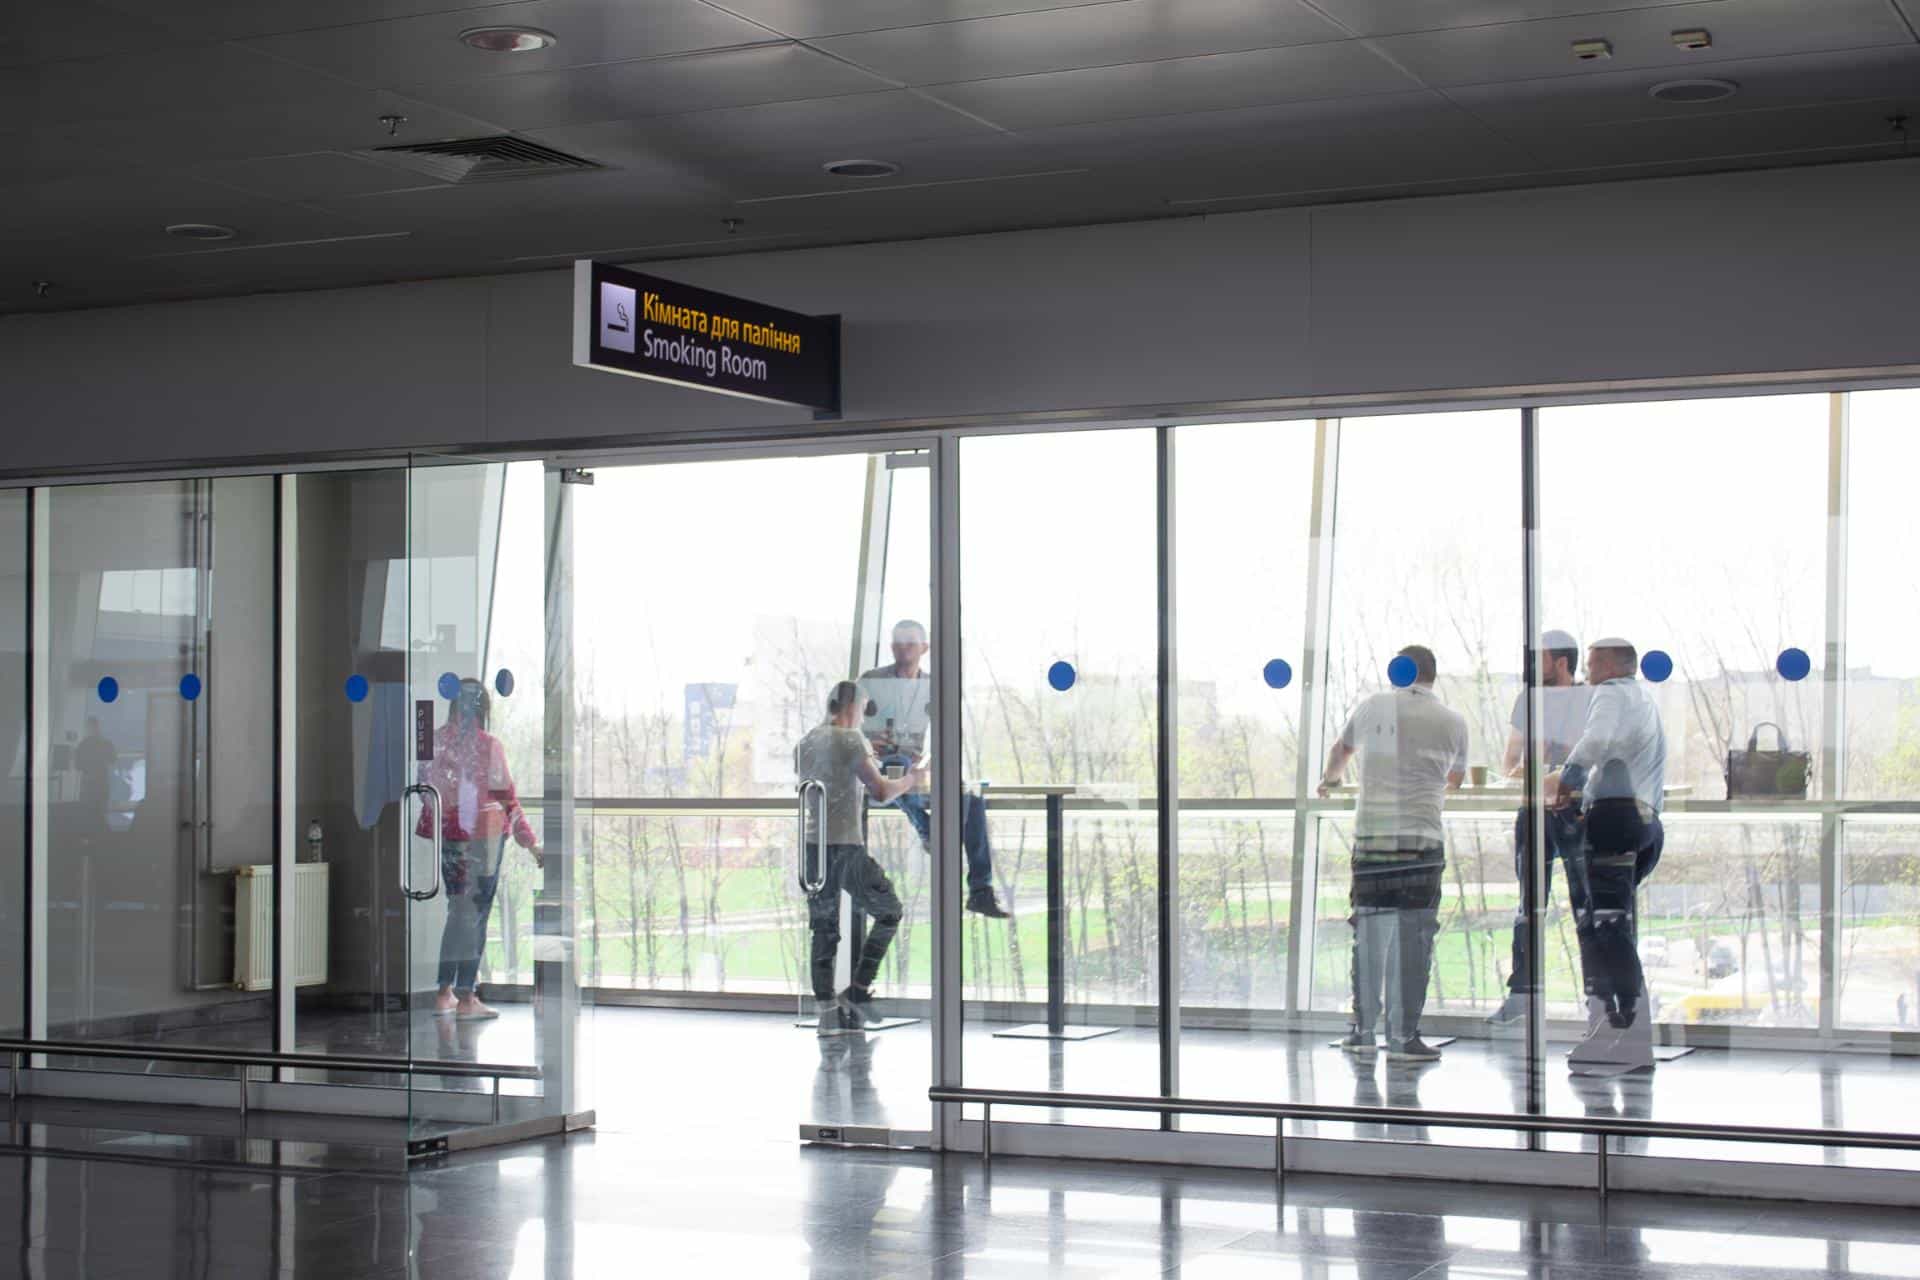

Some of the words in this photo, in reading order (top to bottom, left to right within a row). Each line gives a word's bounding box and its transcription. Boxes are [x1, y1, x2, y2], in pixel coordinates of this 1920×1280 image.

[643, 292, 707, 333] Кімната
[710, 315, 739, 342] для
[742, 322, 801, 354] паління
[643, 329, 717, 377] Smoking
[721, 346, 767, 381] Room
[417, 708, 425, 753] PUSH
